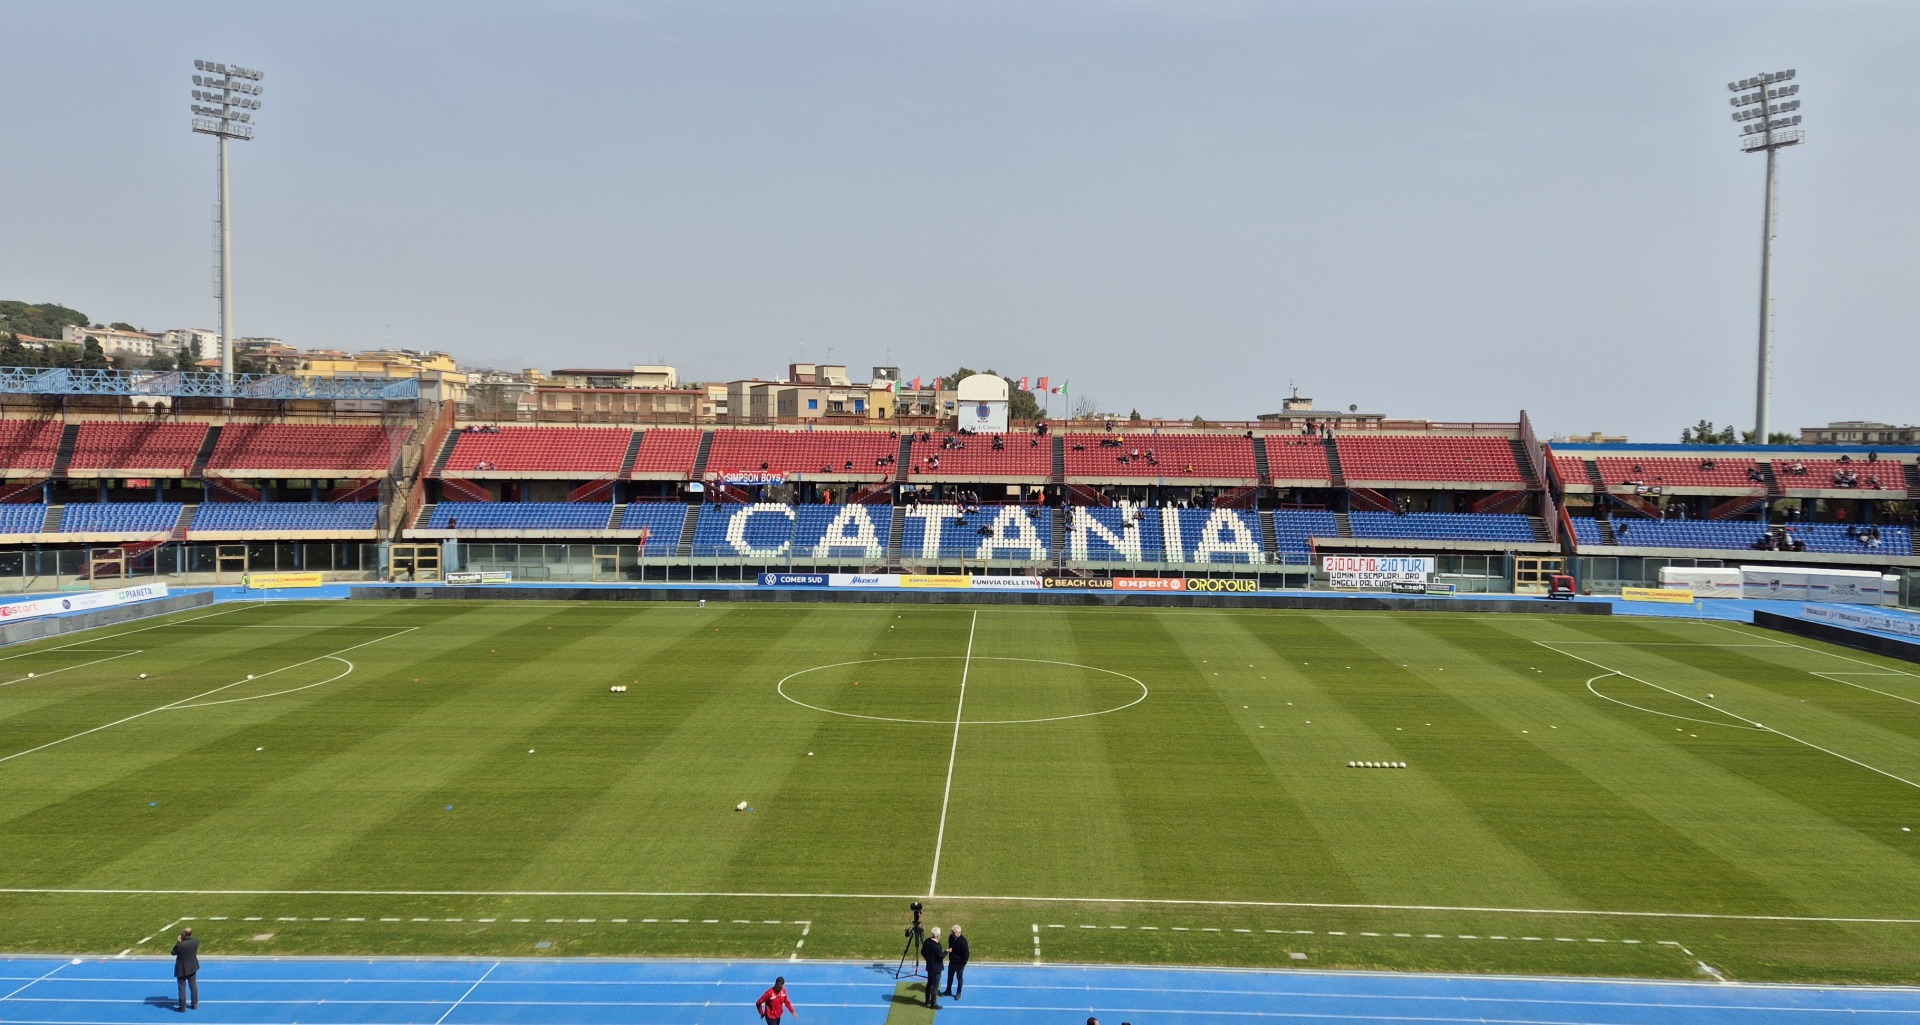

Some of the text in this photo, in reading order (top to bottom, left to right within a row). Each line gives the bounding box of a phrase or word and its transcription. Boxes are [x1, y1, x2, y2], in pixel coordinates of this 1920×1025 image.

[726, 473, 781, 483] SIMPSON BOYS
[725, 502, 1266, 565] CATANIA
[1347, 558, 1376, 572] ALFIO
[1055, 579, 1086, 587] BEACH
[1088, 579, 1113, 588] CLUB
[1118, 580, 1169, 588] expert
[125, 587, 152, 598] PIANETA
